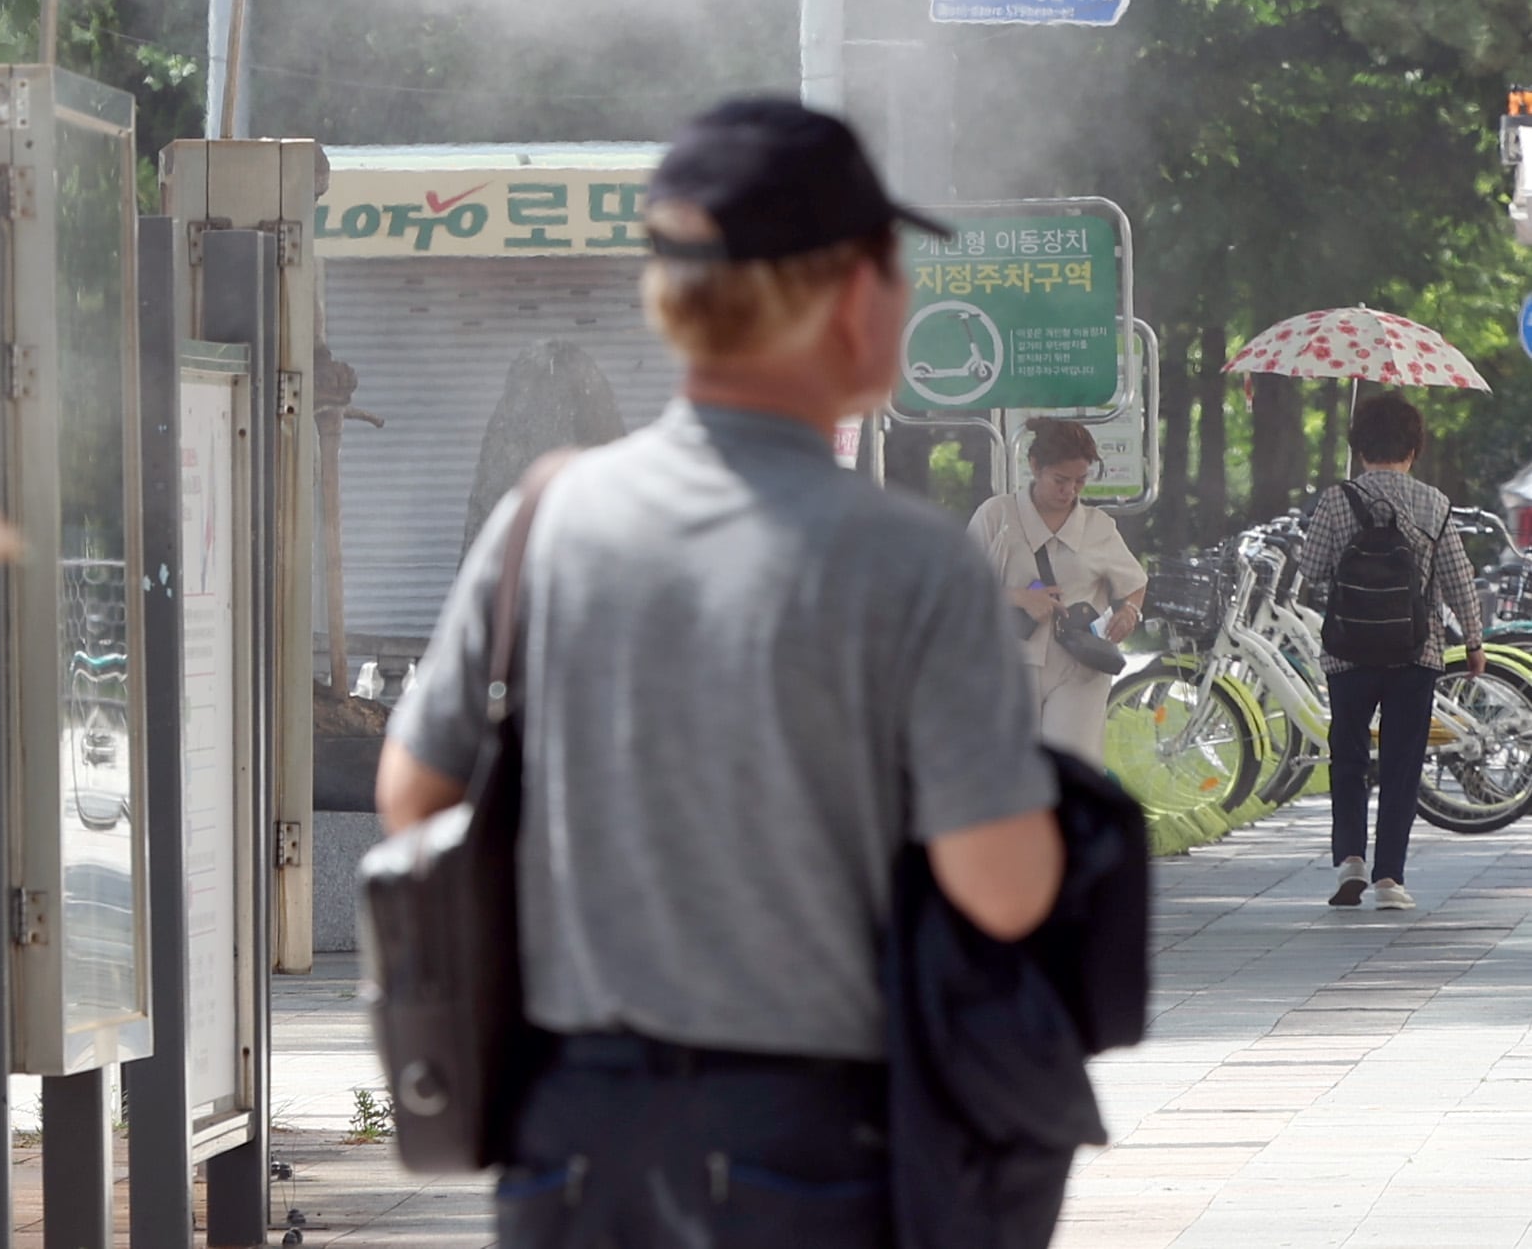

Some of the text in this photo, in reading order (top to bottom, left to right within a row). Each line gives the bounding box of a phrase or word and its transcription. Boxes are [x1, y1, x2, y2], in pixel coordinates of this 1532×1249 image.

[504, 183, 651, 248] 로또
[995, 228, 1088, 254] 이동장치
[915, 261, 1093, 295] 지정주차구역
